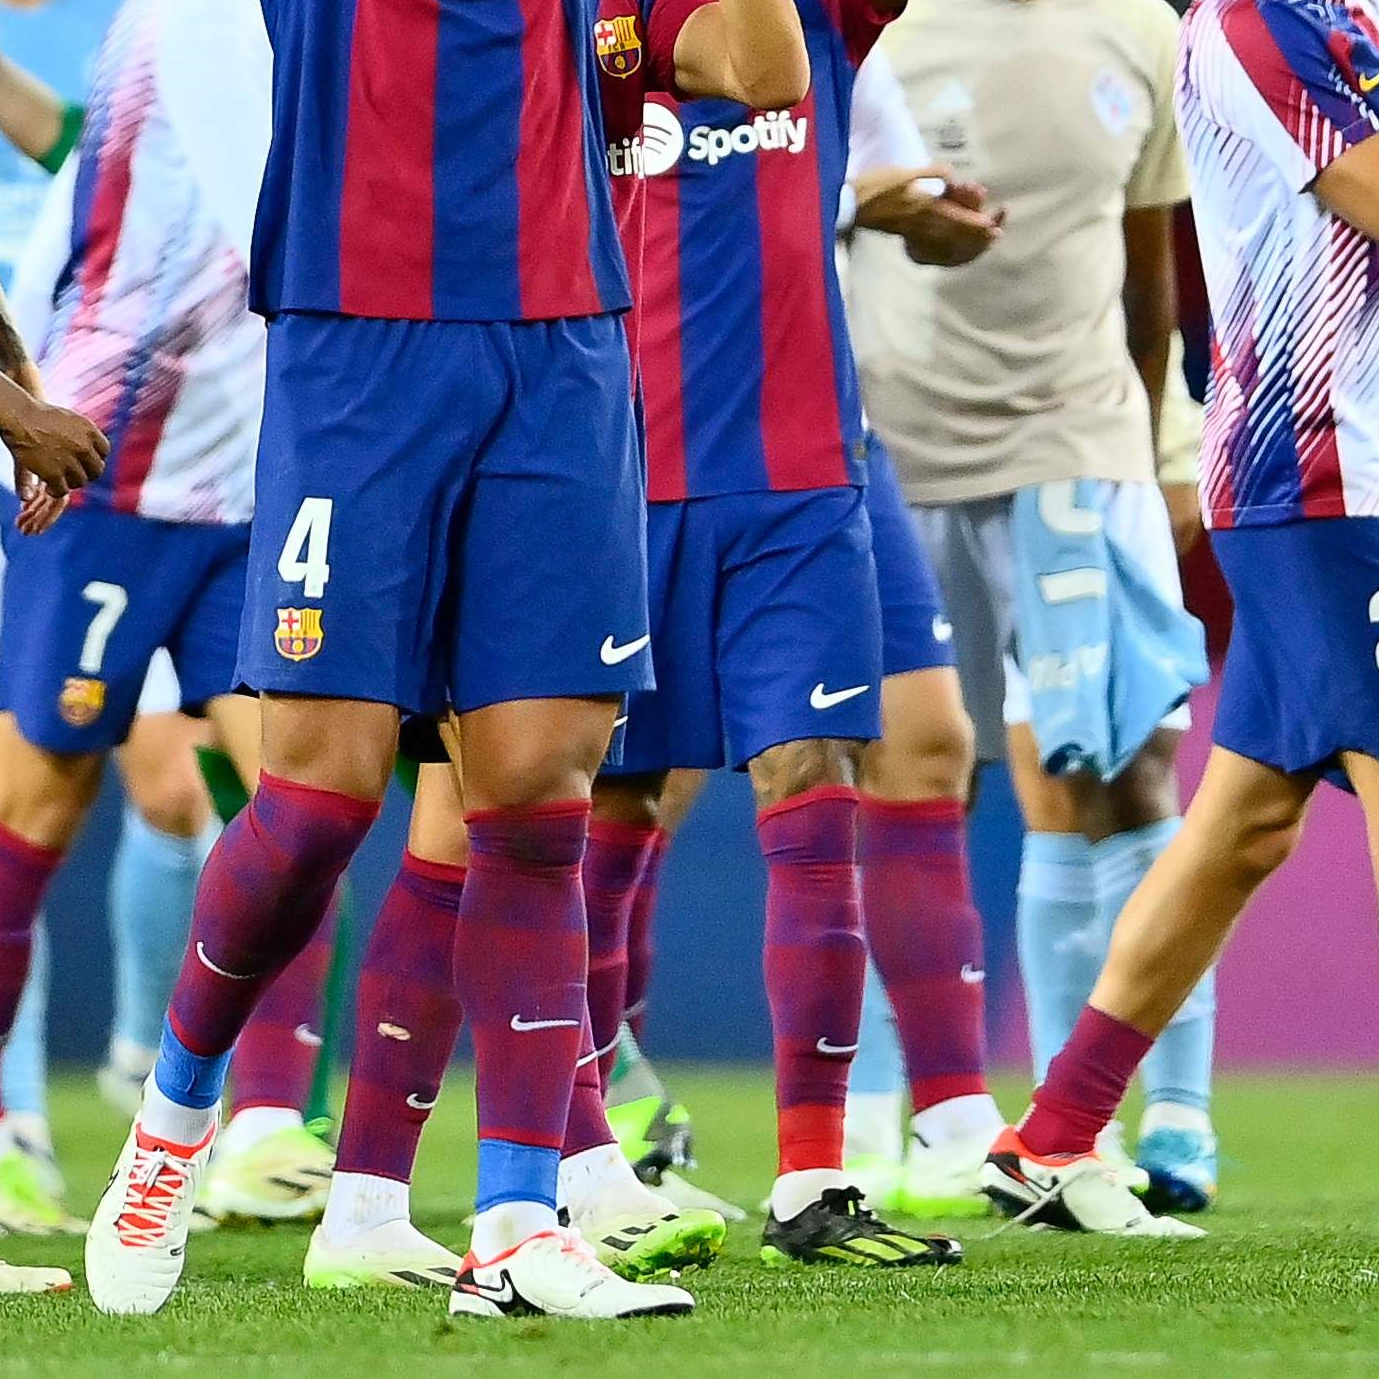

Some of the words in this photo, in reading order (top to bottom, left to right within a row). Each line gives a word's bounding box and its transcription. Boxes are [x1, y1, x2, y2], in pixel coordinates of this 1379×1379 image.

[687, 111, 807, 165] Spotify
[277, 497, 333, 598] 4
[79, 580, 128, 673] 7
